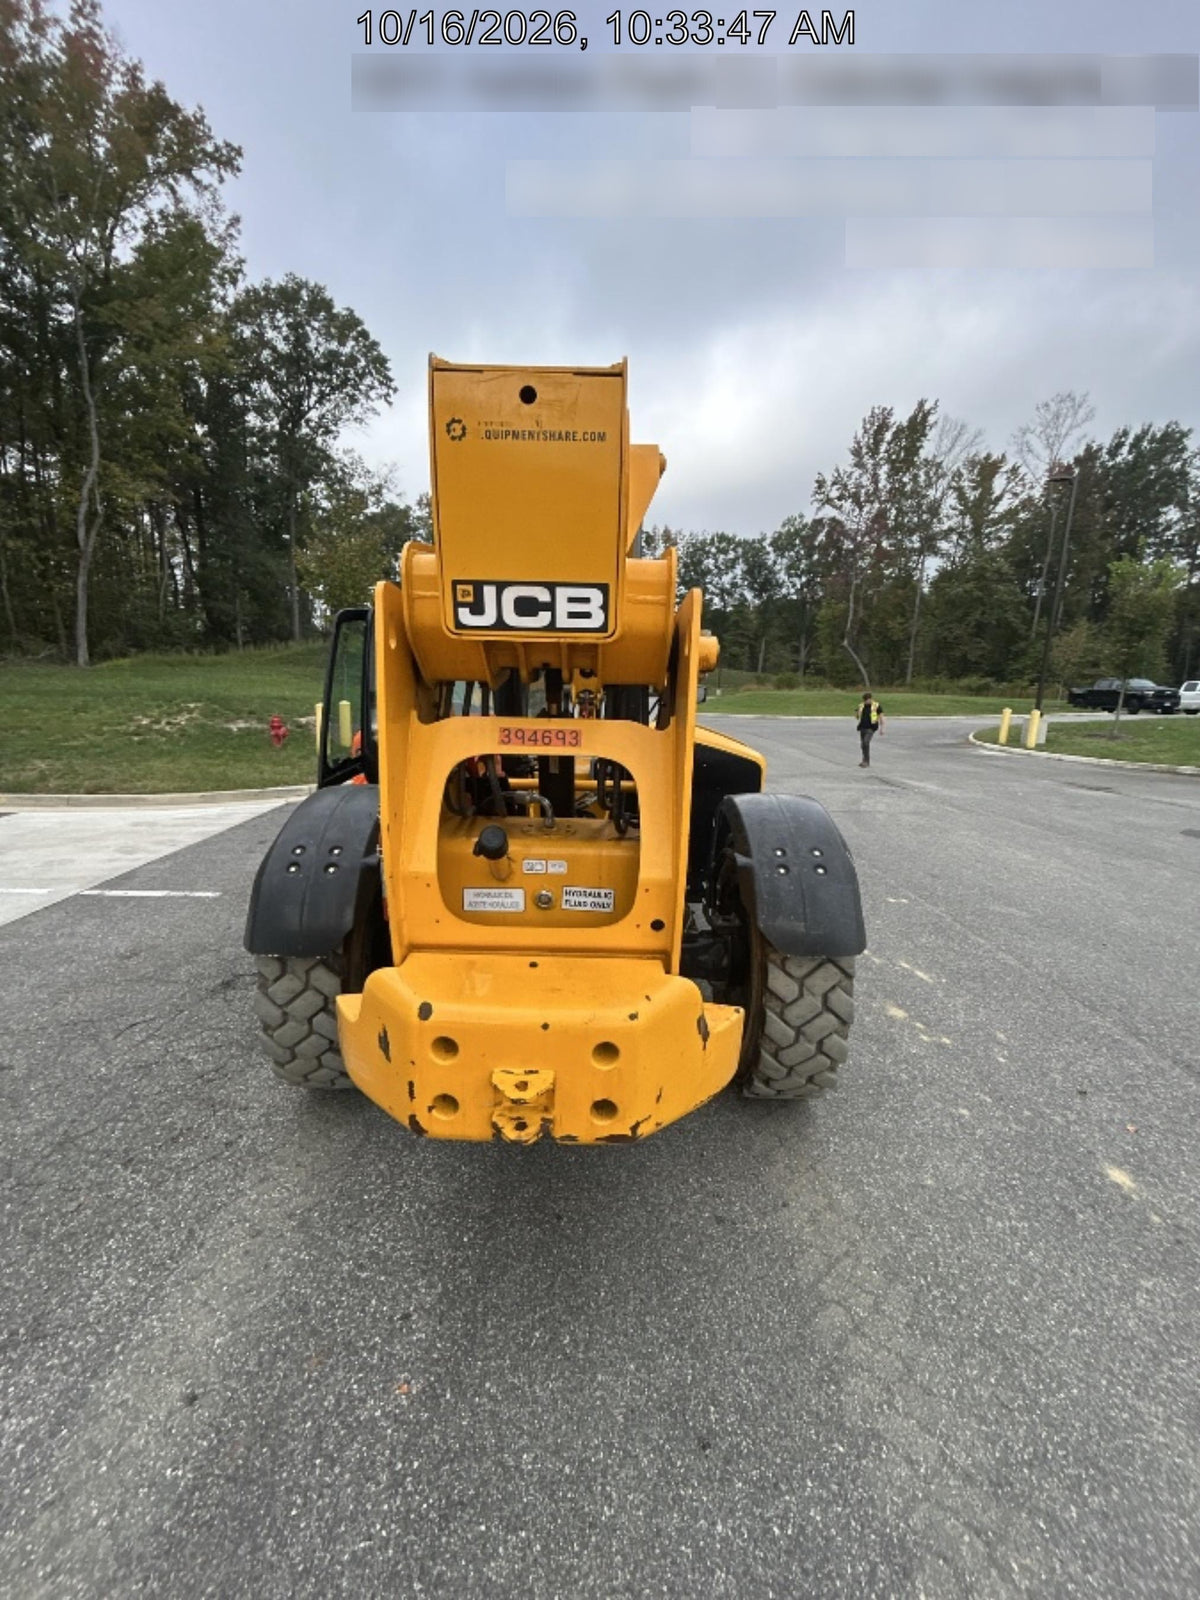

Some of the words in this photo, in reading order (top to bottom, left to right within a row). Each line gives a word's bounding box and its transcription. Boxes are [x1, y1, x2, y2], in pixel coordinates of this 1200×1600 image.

[480, 429, 607, 442] QUIPMENTSHARE.COM
[457, 584, 605, 628] JCB
[501, 728, 579, 747] 394693
